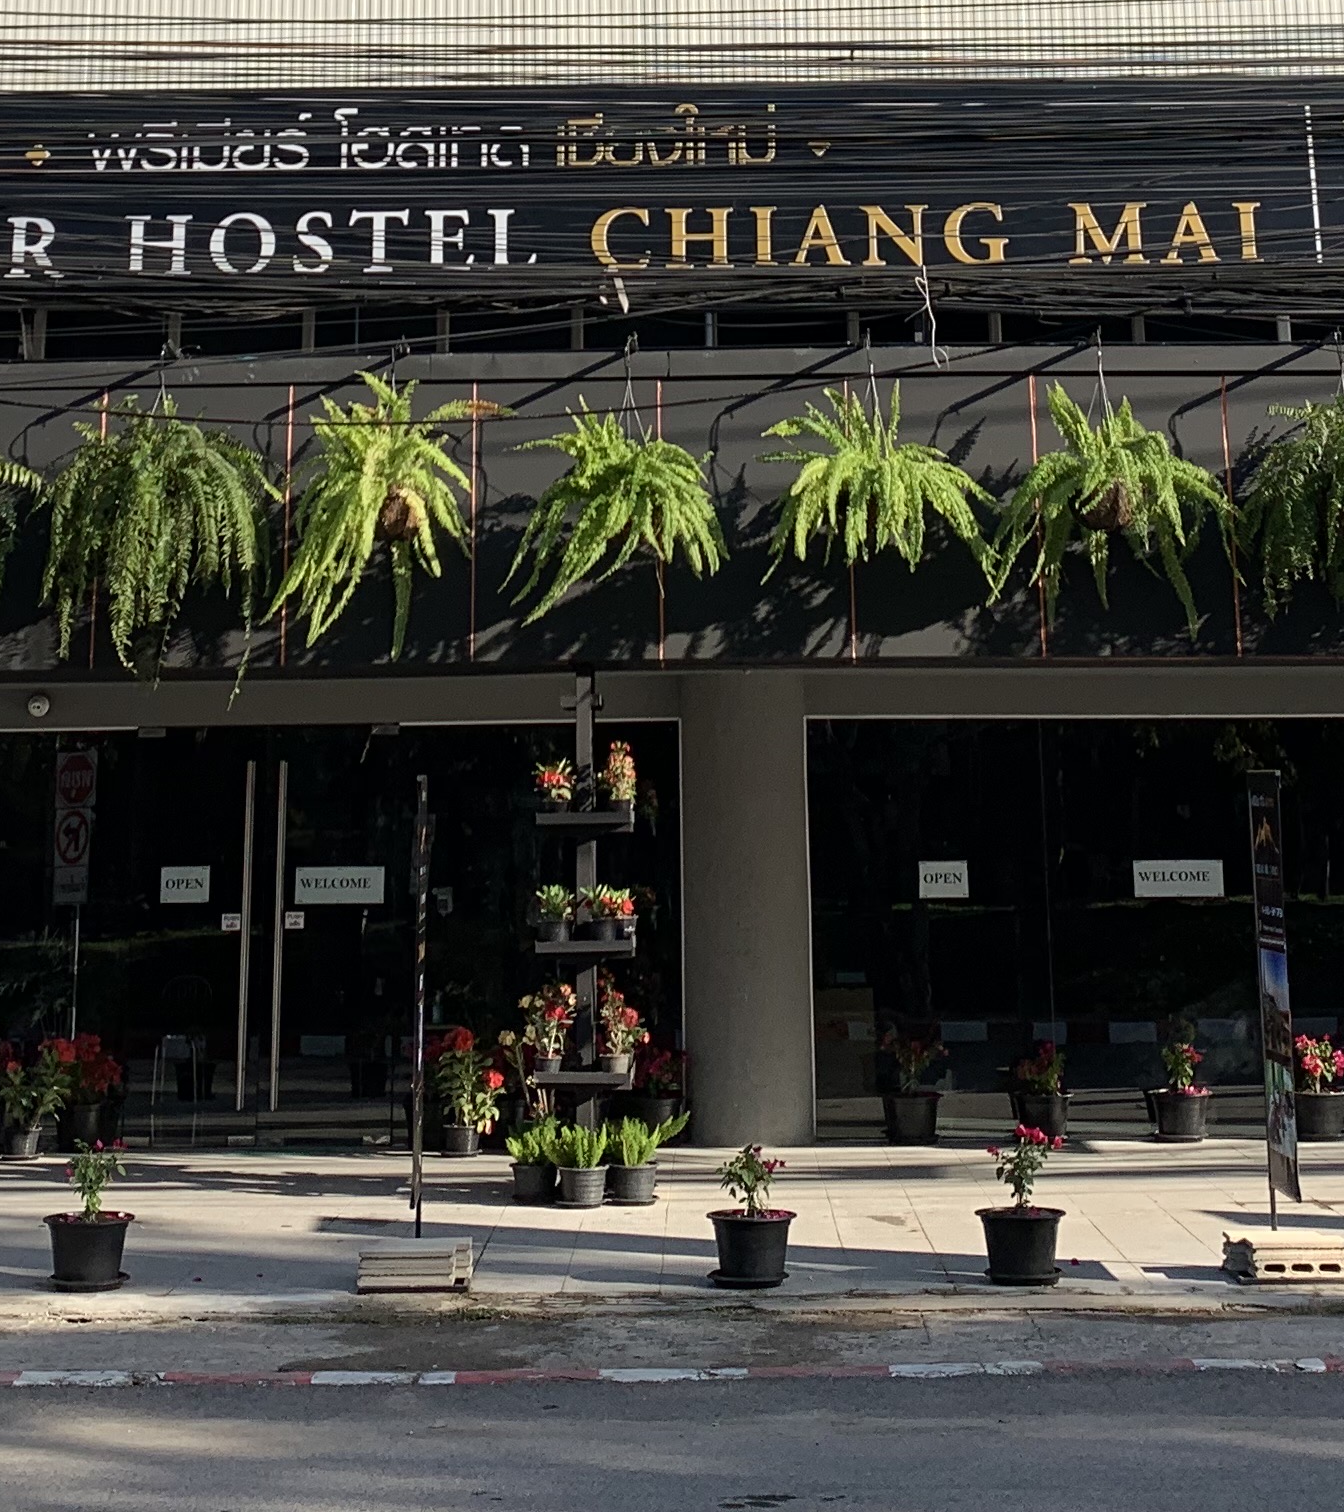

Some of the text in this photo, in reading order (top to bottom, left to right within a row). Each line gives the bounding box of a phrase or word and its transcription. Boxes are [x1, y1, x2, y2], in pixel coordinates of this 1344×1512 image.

[125, 208, 537, 275] HOSTEL
[589, 202, 1009, 272] CHIANG
[1067, 201, 1264, 265] MAI
[923, 873, 963, 884] OPEN
[1138, 870, 1210, 882] WELCOME
[165, 878, 204, 889] OPEN
[300, 877, 371, 889] WELCOME
